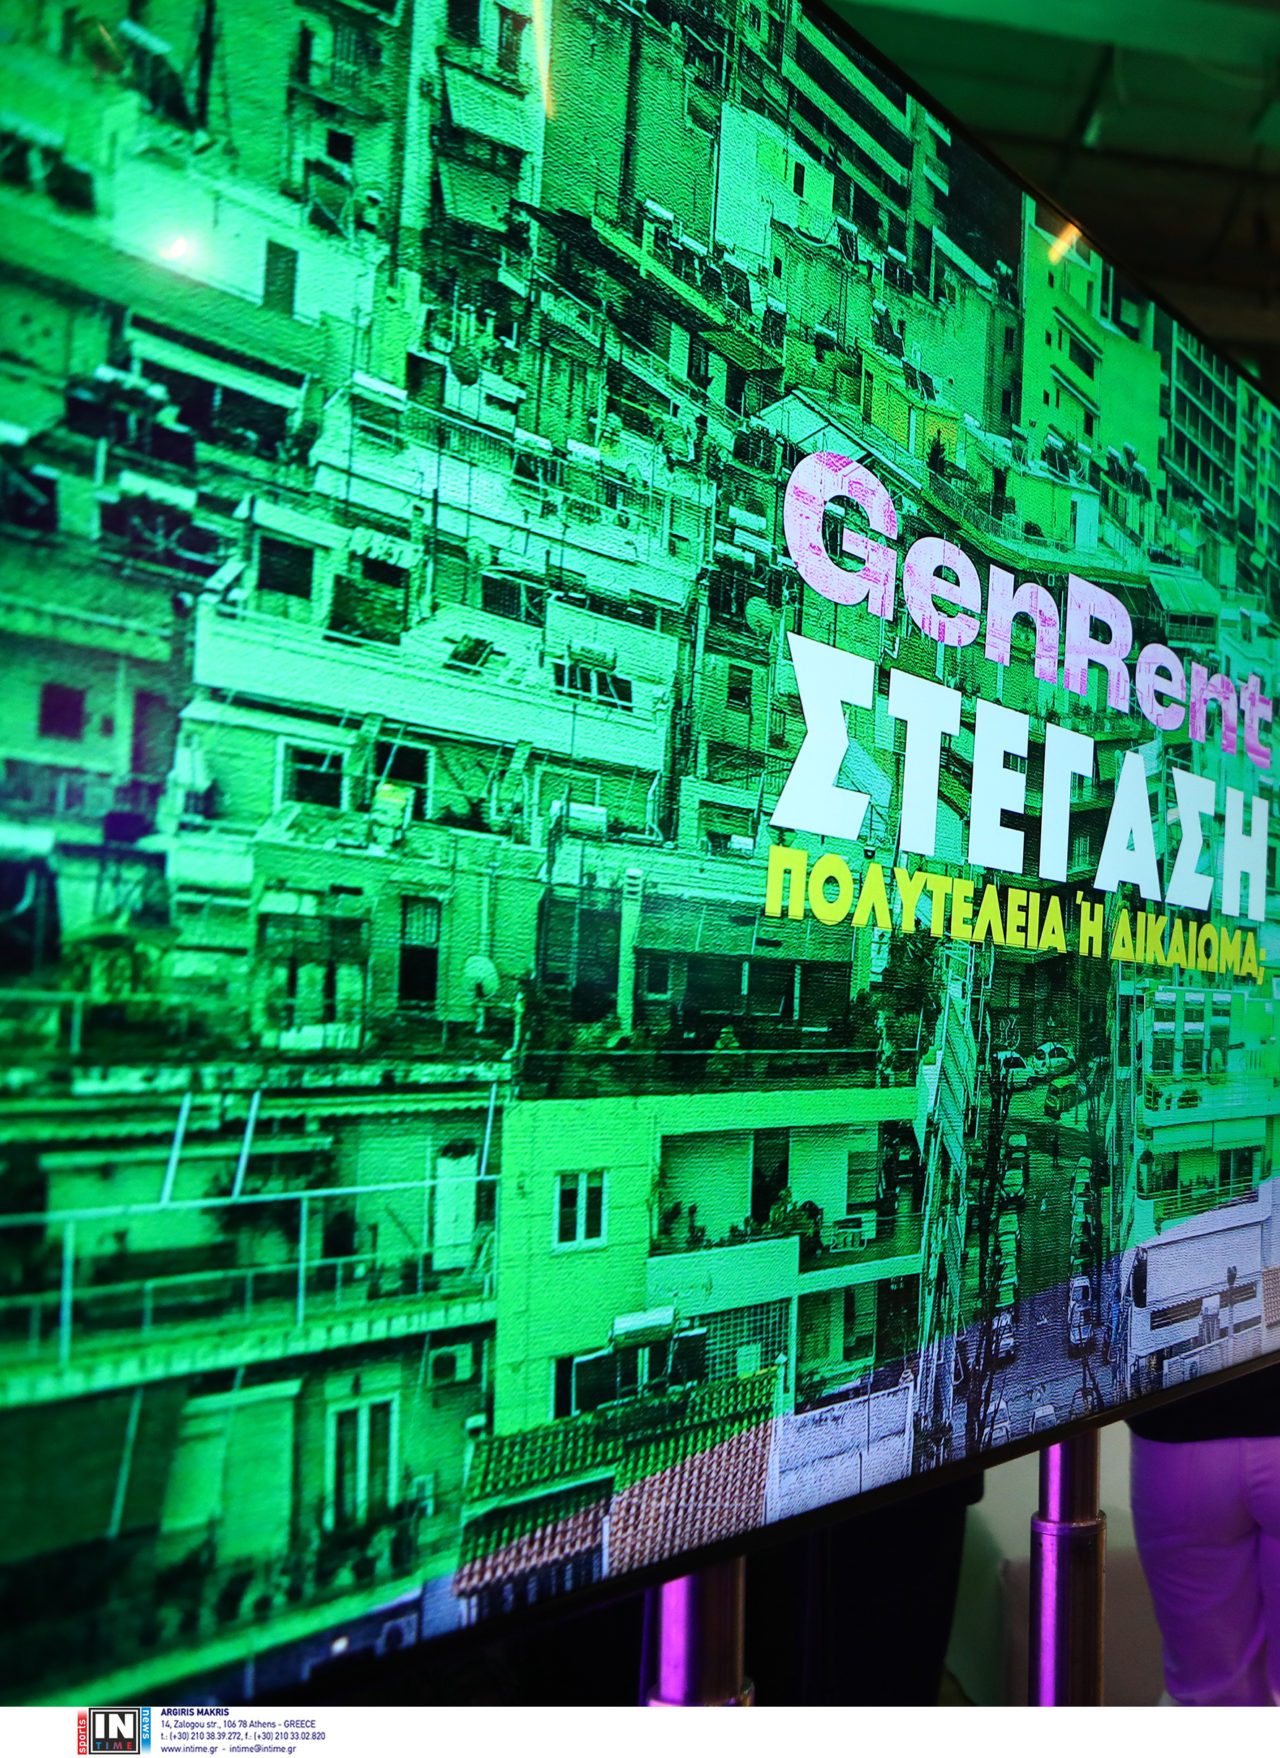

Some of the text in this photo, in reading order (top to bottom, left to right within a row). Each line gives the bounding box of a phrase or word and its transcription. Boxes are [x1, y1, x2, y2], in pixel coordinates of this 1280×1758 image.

[783, 450, 1272, 769] GenRent
[764, 845, 1067, 953] ΠΟΛΥΤΕΛΕΙΑ
[1110, 908, 1267, 985] ΔΙΚΑΙΩΜΑ;
[768, 631, 1269, 922] ΣΤΕΓΑΣΗ
